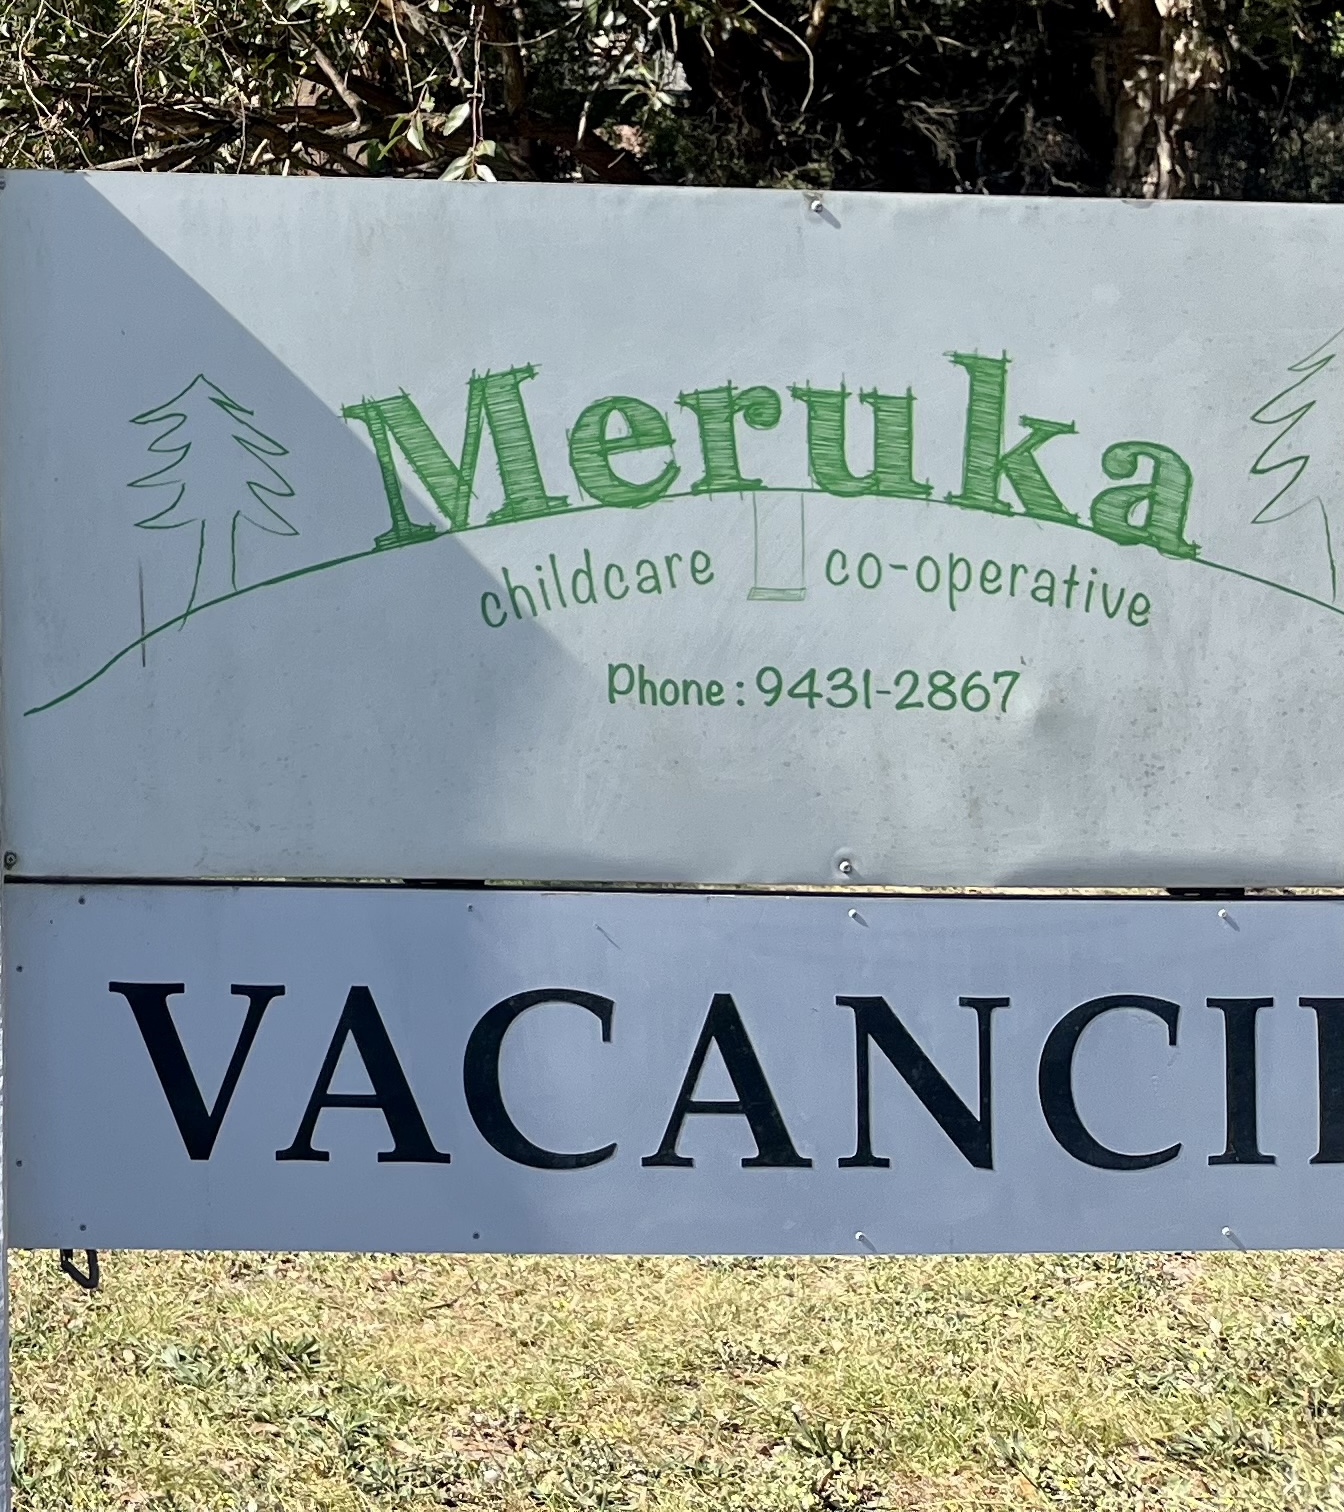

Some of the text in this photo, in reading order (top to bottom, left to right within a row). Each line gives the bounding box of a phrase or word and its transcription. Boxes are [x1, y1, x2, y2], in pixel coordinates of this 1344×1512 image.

[340, 350, 1202, 559] Meruka
[480, 545, 1153, 629] childcare co-operative
[755, 665, 1021, 713] 9431-2867
